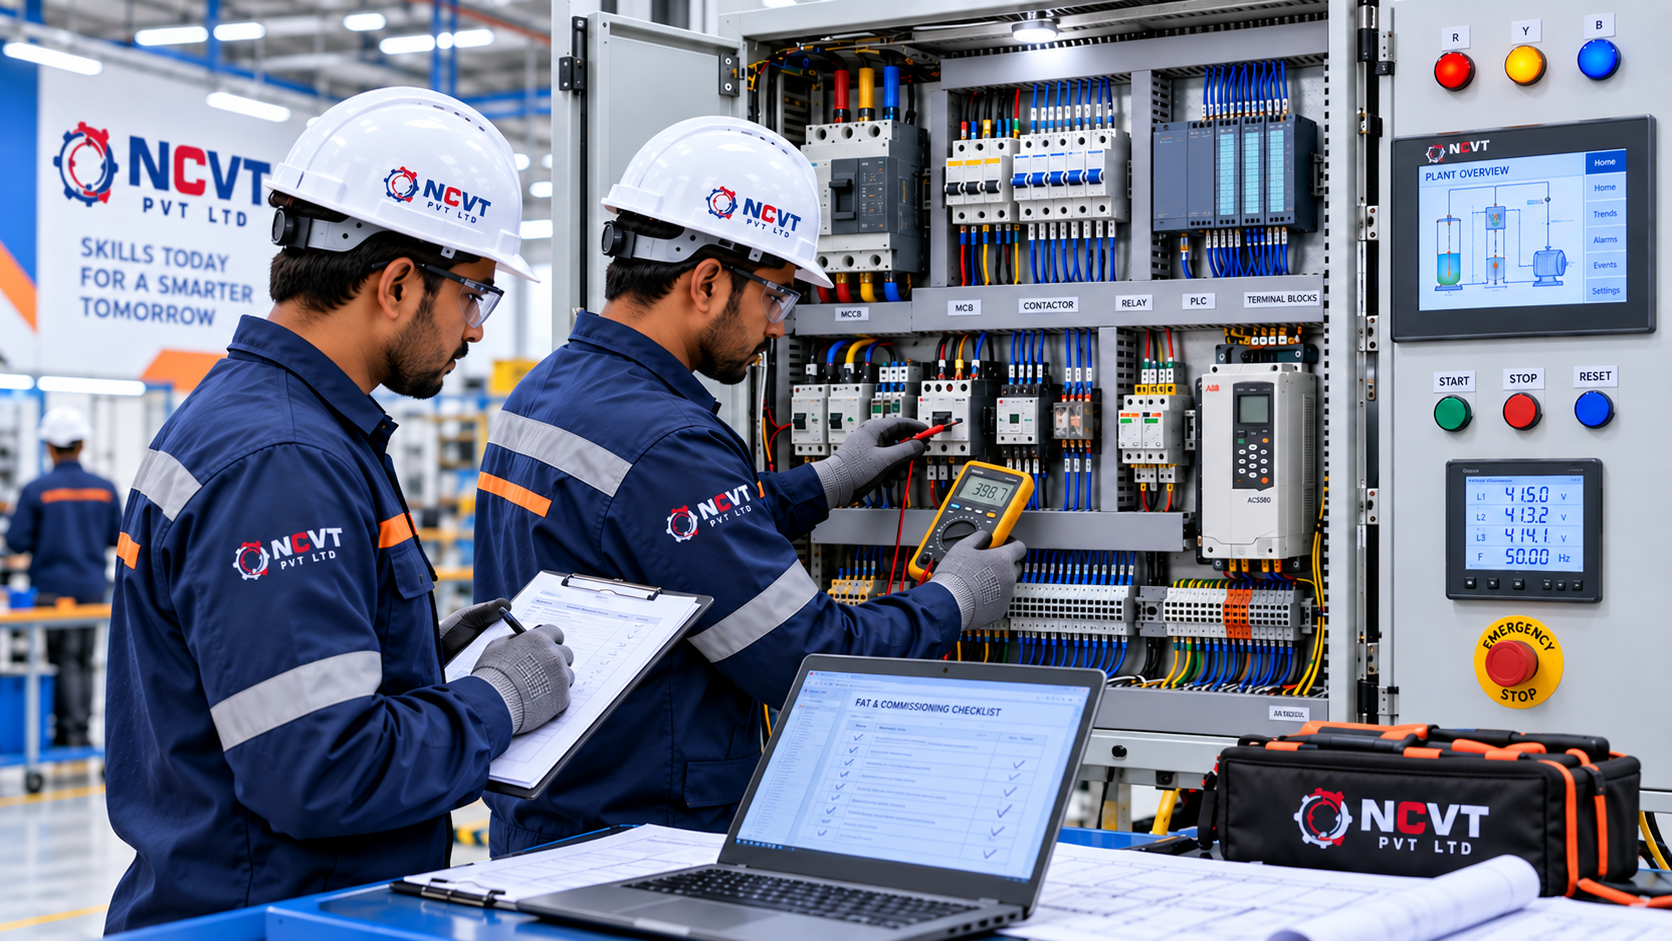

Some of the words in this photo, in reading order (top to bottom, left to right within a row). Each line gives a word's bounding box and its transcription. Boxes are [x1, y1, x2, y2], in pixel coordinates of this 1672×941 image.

[1522, 26, 1530, 36] Y
[1595, 20, 1603, 30] B
[1452, 33, 1460, 42] R
[1449, 139, 1490, 154] NCVT
[128, 134, 271, 206] NCVT
[1594, 158, 1616, 167] Home
[1425, 170, 1456, 181] PLANT
[1459, 166, 1510, 178] OVERVIEW
[1594, 183, 1616, 192] Home
[423, 179, 491, 217] NCVT
[142, 197, 189, 219] PVT
[208, 206, 247, 227] LTD
[427, 201, 450, 213] PVT
[457, 211, 477, 223] LTD
[742, 197, 802, 232] NCVT
[1593, 210, 1618, 219] Trends
[746, 218, 766, 230] PVT
[772, 227, 789, 238] LTD
[1593, 235, 1618, 244] Alarms
[80, 236, 154, 264] SKILLS
[161, 247, 229, 273] TODAY
[1593, 260, 1618, 270] Events
[80, 266, 125, 290] FOR
[134, 273, 149, 292] A
[158, 275, 254, 303] SMARTER
[1592, 286, 1621, 296] Settings
[1023, 301, 1074, 310] CONTACTOR
[1121, 299, 1147, 308] RELAY
[1190, 297, 1207, 306] PLC
[1247, 295, 1285, 304] TERMINAL
[1287, 293, 1318, 303] BLOCKS
[80, 296, 216, 326] TOMORROW
[1439, 375, 1470, 387] START
[1509, 373, 1538, 384] STOP
[1579, 370, 1612, 382] RESET
[972, 482, 1009, 502] 398.7
[1476, 493, 1486, 501] L1
[697, 484, 751, 520] NCVT
[709, 513, 729, 528] PVT
[734, 505, 752, 517] LTD
[271, 527, 343, 560] NCVT
[1476, 534, 1486, 542] L3
[1560, 534, 1567, 542] V
[280, 556, 304, 570] PVT
[312, 550, 336, 562] LTD
[1477, 553, 1484, 562] F
[1505, 548, 1549, 565] 50.00
[1558, 553, 1571, 563] Hz
[1482, 621, 1555, 652] EMERGENCY
[1500, 687, 1537, 702] STOP
[855, 698, 872, 708] FAT
[872, 700, 879, 708] &
[880, 700, 950, 714] COMMISSIONING
[951, 705, 1002, 717] CHECKLIST
[1360, 798, 1490, 838] NCVT
[1379, 836, 1418, 851] PVT
[1434, 840, 1472, 856] LTD
